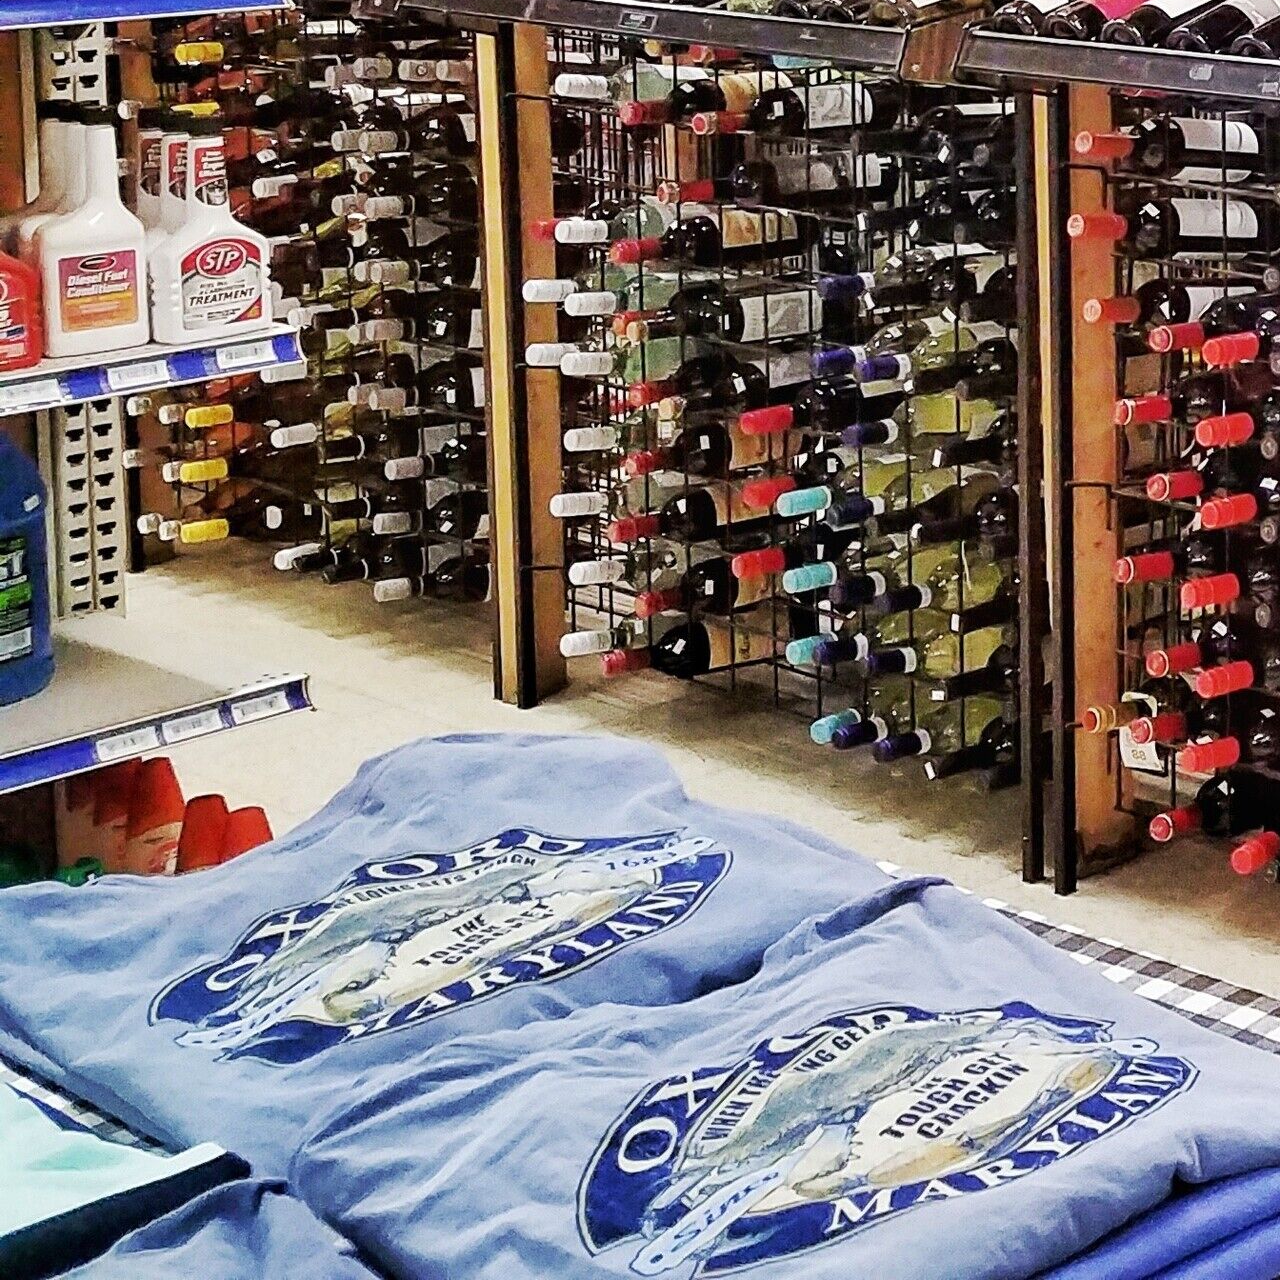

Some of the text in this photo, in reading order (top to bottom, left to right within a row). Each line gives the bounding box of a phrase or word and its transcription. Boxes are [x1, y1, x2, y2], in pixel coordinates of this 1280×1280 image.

[204, 246, 237, 272] STP
[67, 271, 101, 287] Diesel
[189, 287, 254, 307] TREATMENT
[353, 881, 402, 901] GOING
[207, 830, 587, 992] OXORD
[455, 913, 486, 937] THE
[879, 1051, 1018, 1139] TOUGH GET
[915, 1061, 1032, 1141] CRACKIN
[702, 1098, 743, 1142] WHEN
[824, 1056, 1186, 1236] MARYLAN
